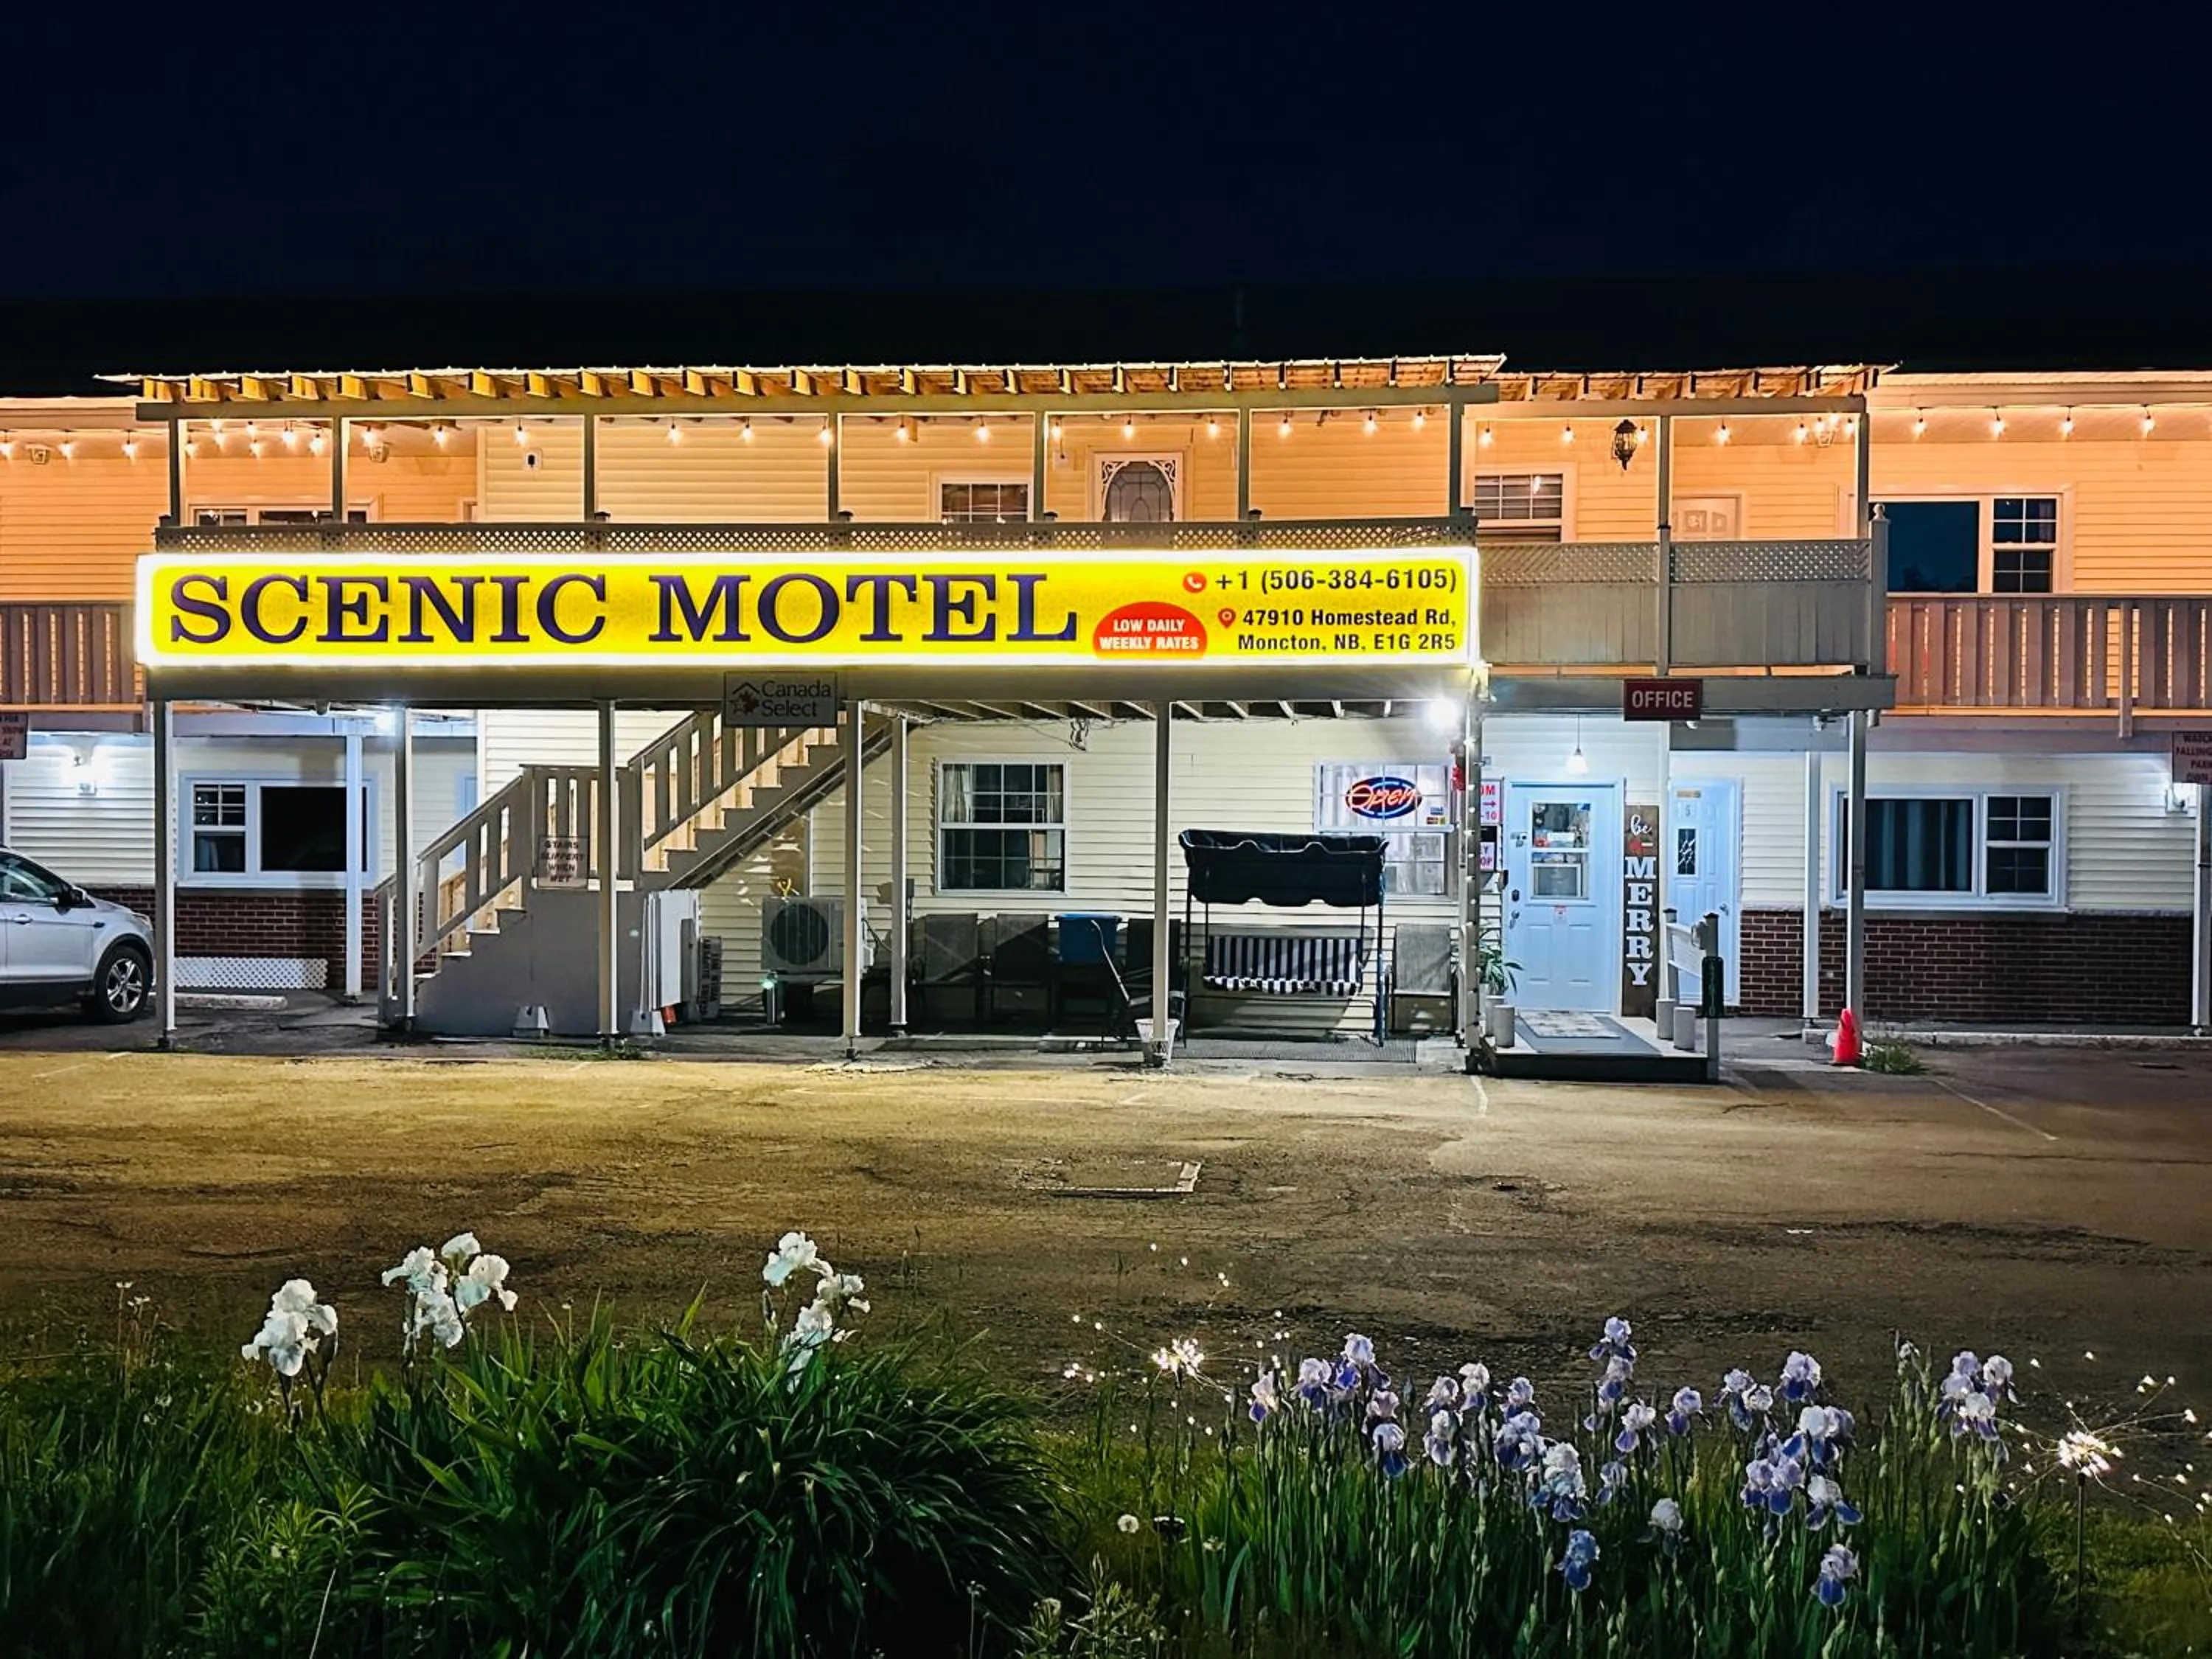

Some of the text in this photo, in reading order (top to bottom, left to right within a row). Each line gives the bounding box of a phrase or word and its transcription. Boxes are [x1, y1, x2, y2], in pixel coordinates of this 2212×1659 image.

[1262, 568, 1457, 595] (506-384-6105)
[170, 572, 1078, 644] SCENIC MOTEL
[1242, 608, 1456, 627] 47910 Homestead Rd,
[1113, 619, 1185, 633] LOW DAILY
[1099, 636, 1199, 650] WEEKLY RATES
[1238, 633, 1327, 651] Moncton,
[1374, 633, 1411, 650] E1G
[1418, 633, 1455, 650] 2R5
[761, 679, 831, 698] Canada
[761, 700, 818, 717] Select
[1632, 690, 1694, 709] OFFICE
[1347, 784, 1417, 809] Open
[1630, 813, 1652, 836] be
[1624, 855, 1657, 987] MERRY
